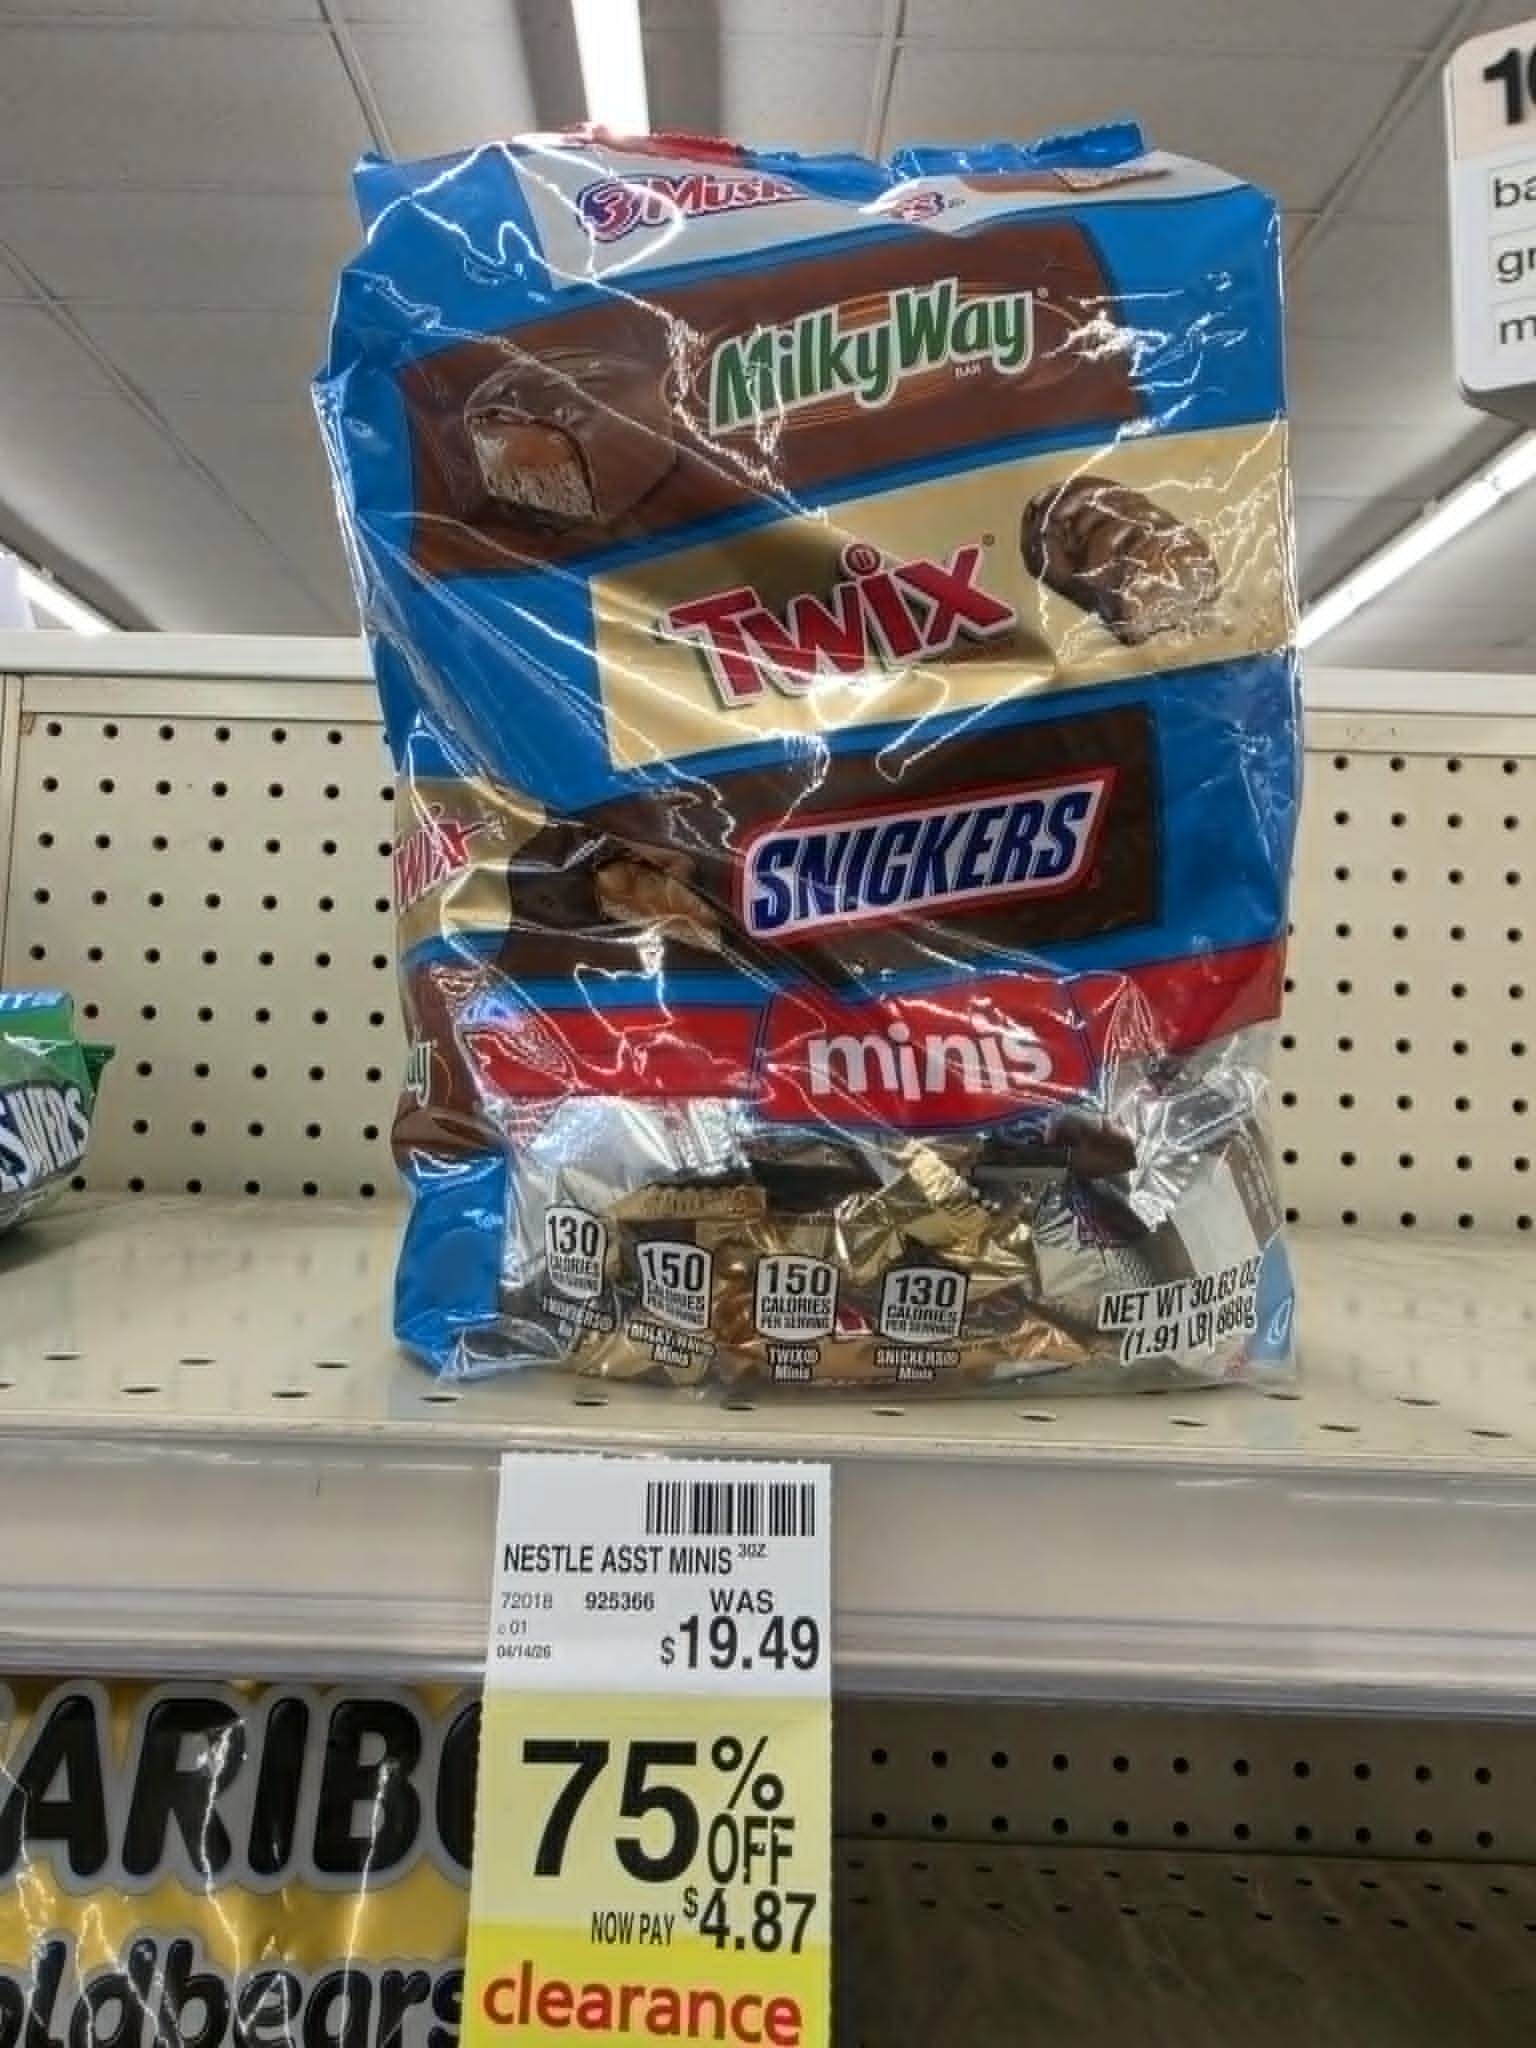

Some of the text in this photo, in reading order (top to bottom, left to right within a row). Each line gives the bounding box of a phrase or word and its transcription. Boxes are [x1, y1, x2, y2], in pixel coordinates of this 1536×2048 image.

[1482, 46, 1536, 127] 1
[752, 791, 1092, 932] SNICKERS
[807, 1023, 1053, 1100] minis
[548, 1215, 600, 1257] 130
[642, 1247, 705, 1292] 150
[766, 1262, 832, 1297] 150
[760, 1296, 830, 1315] CALORIES
[895, 1275, 958, 1307] 130
[1102, 1291, 1150, 1325] NET
[1156, 1285, 1186, 1319] WT
[887, 1304, 958, 1324] CALORIES
[1122, 1322, 1180, 1361] (1.91
[503, 1544, 594, 1573] NESTLE
[601, 1544, 664, 1574] ASST
[669, 1546, 732, 1575] MINIS
[584, 1591, 655, 1612] 925366
[710, 1589, 774, 1614] WAS
[659, 1615, 819, 1670] $19.49
[708, 1813, 795, 1885] OFF
[591, 1886, 817, 1955] NOW PAY $4.87
[483, 1960, 803, 2047] clearance
